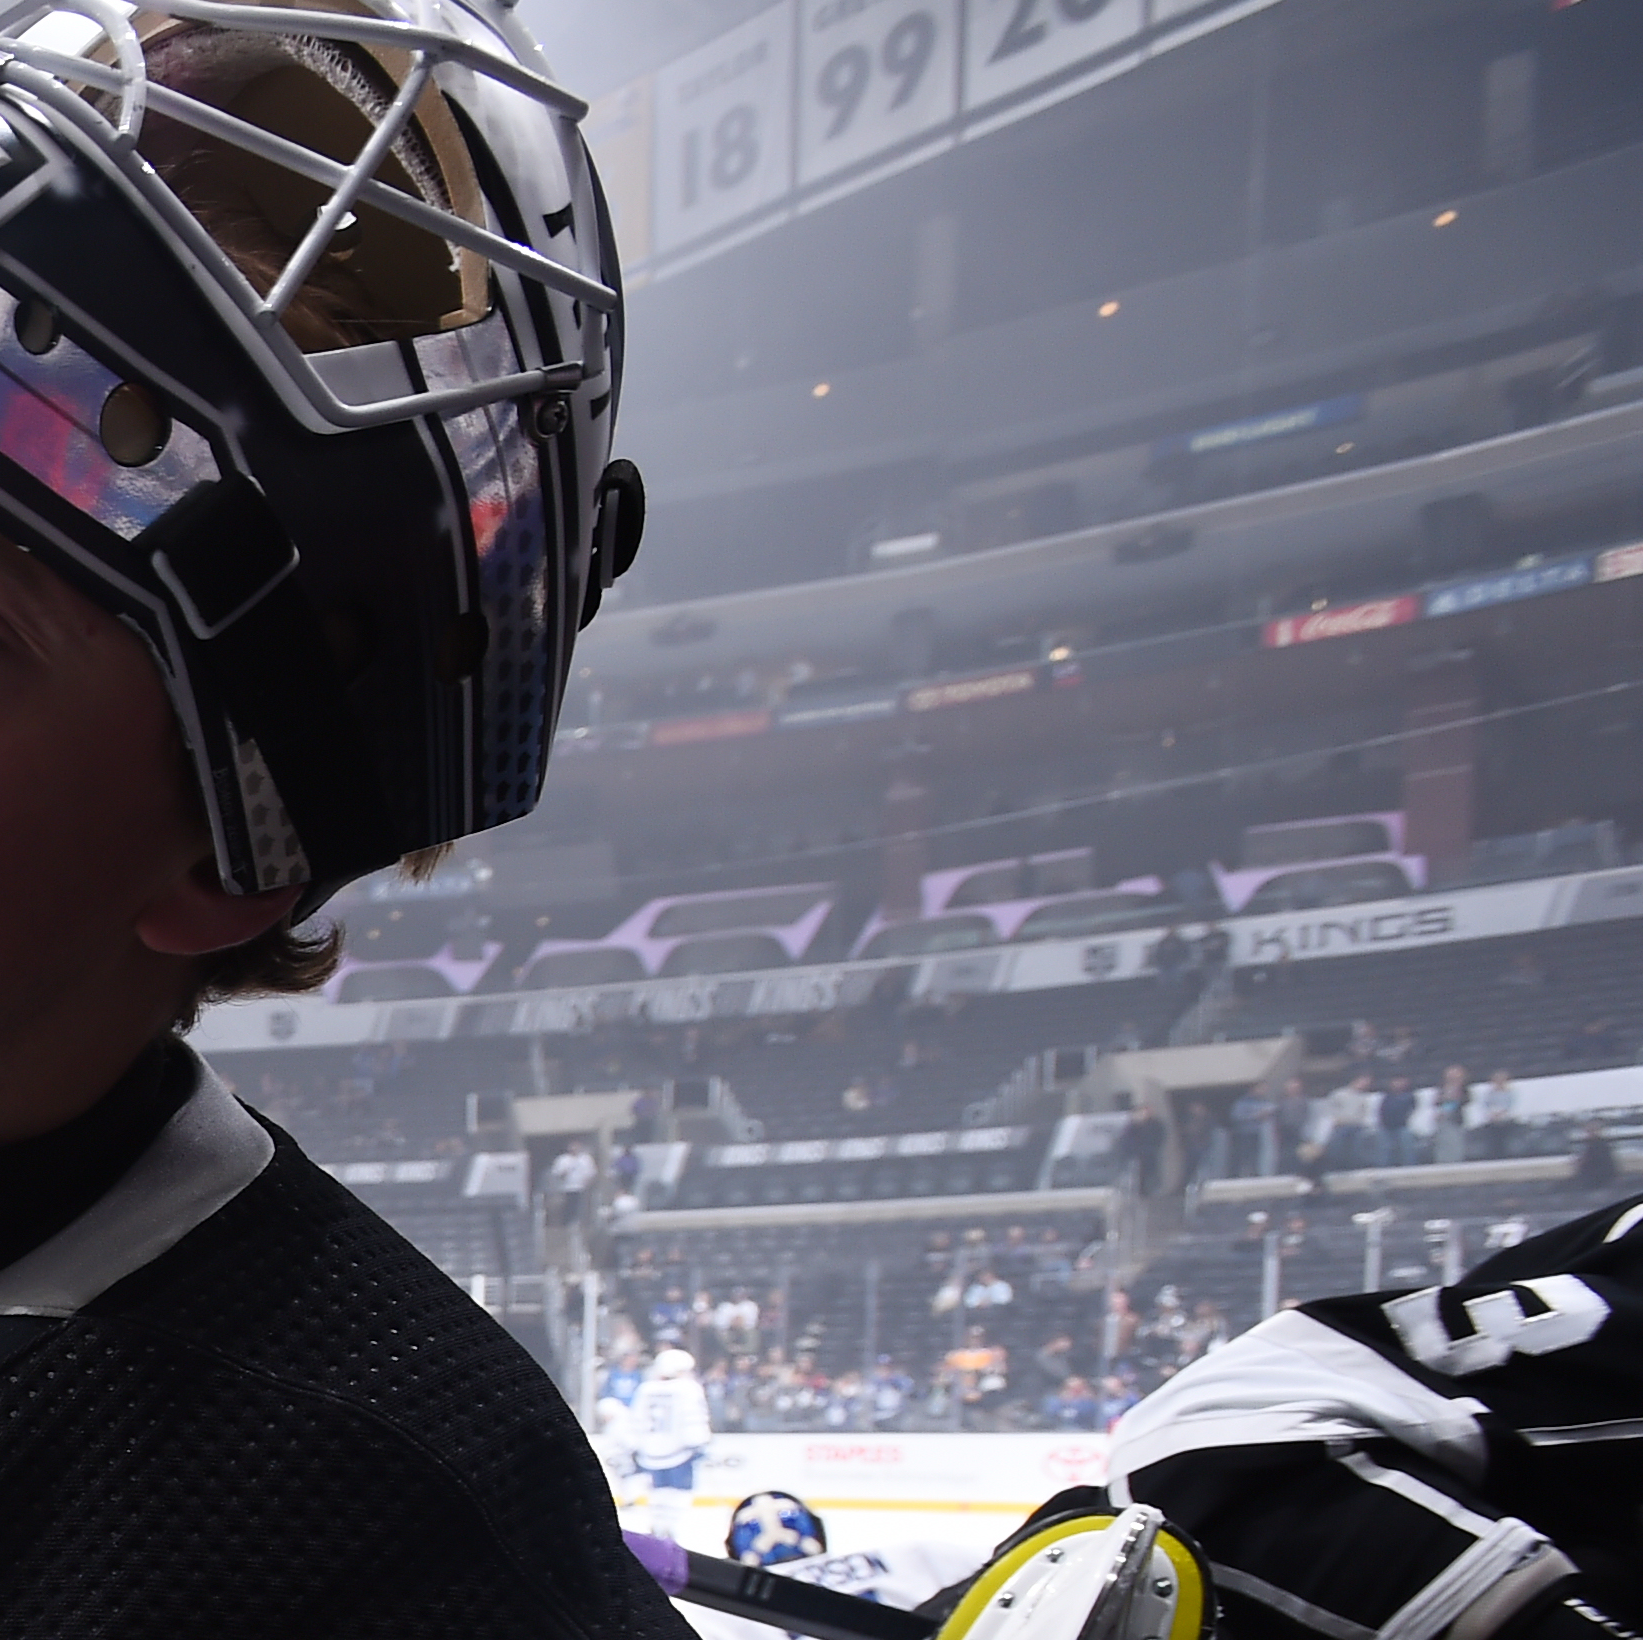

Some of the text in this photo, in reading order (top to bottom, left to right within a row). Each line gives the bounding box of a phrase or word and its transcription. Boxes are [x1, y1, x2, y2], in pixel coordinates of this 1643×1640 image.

[816, 10, 938, 142] 99
[986, 0, 1111, 68] 2
[680, 104, 761, 210] 18
[1251, 906, 1457, 958] KINGS
